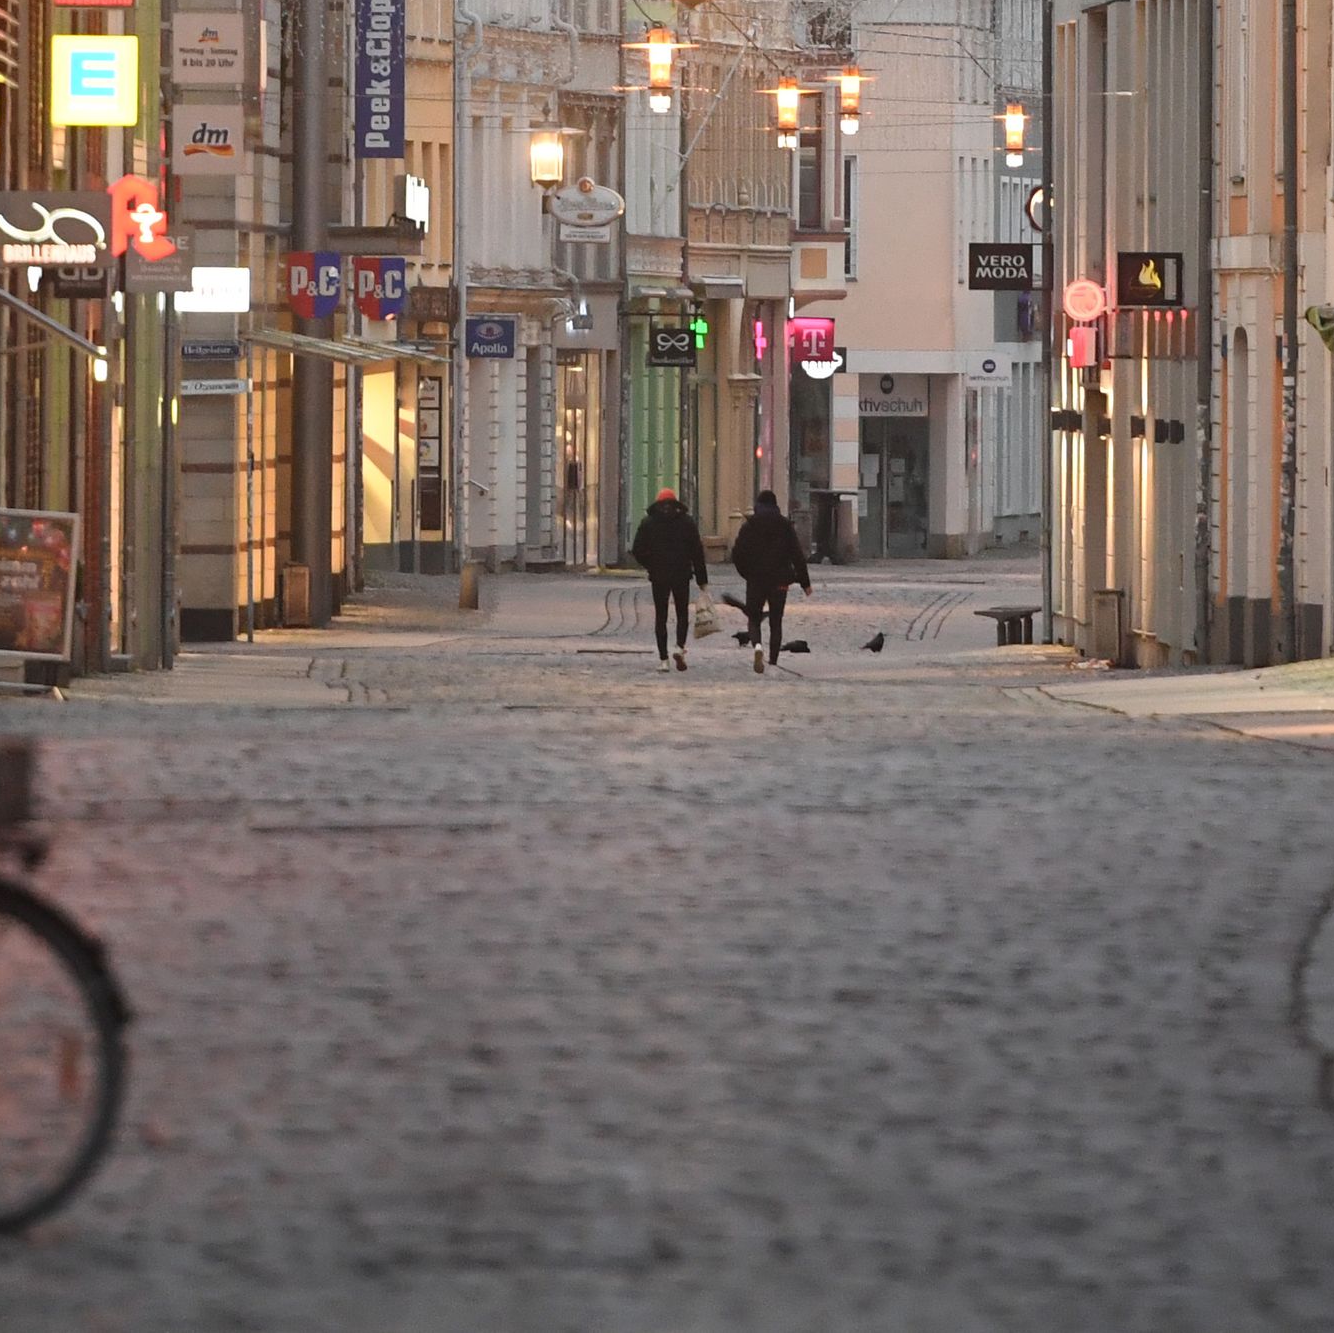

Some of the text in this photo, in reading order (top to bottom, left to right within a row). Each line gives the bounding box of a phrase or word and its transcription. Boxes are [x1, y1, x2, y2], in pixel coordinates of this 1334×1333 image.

[190, 59, 203, 67] bis
[218, 59, 235, 67] Uhr
[192, 122, 229, 143] dm
[3, 244, 96, 264] BRILLENHAUS
[978, 255, 1025, 267] VERO
[976, 267, 1028, 279] MODA
[358, 270, 402, 299] P&C
[471, 342, 508, 355] Apollo
[858, 397, 923, 412] ktivschuh
